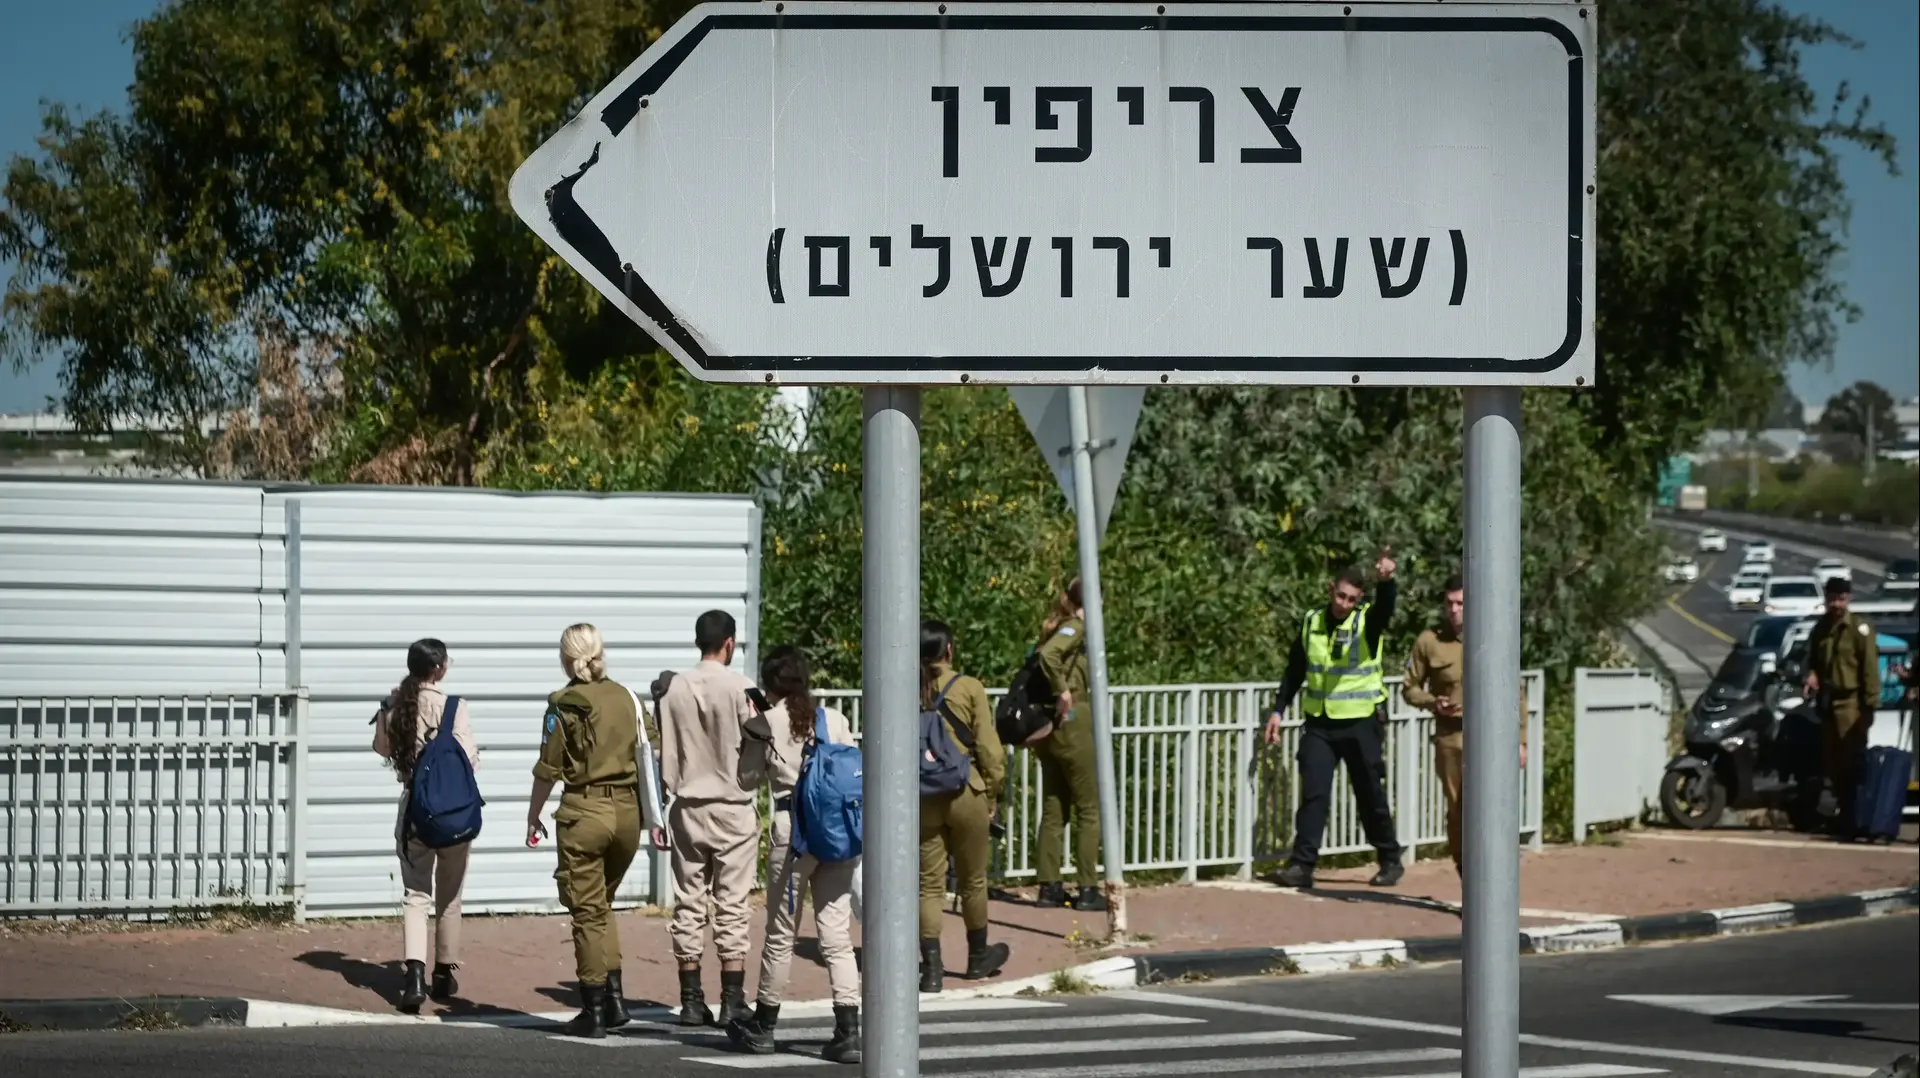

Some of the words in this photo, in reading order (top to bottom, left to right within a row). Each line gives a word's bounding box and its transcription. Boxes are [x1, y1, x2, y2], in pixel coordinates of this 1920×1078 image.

[931, 86, 1302, 178] צריפין
[766, 224, 1171, 304] ירושלים)
[1246, 229, 1468, 306] (שער
